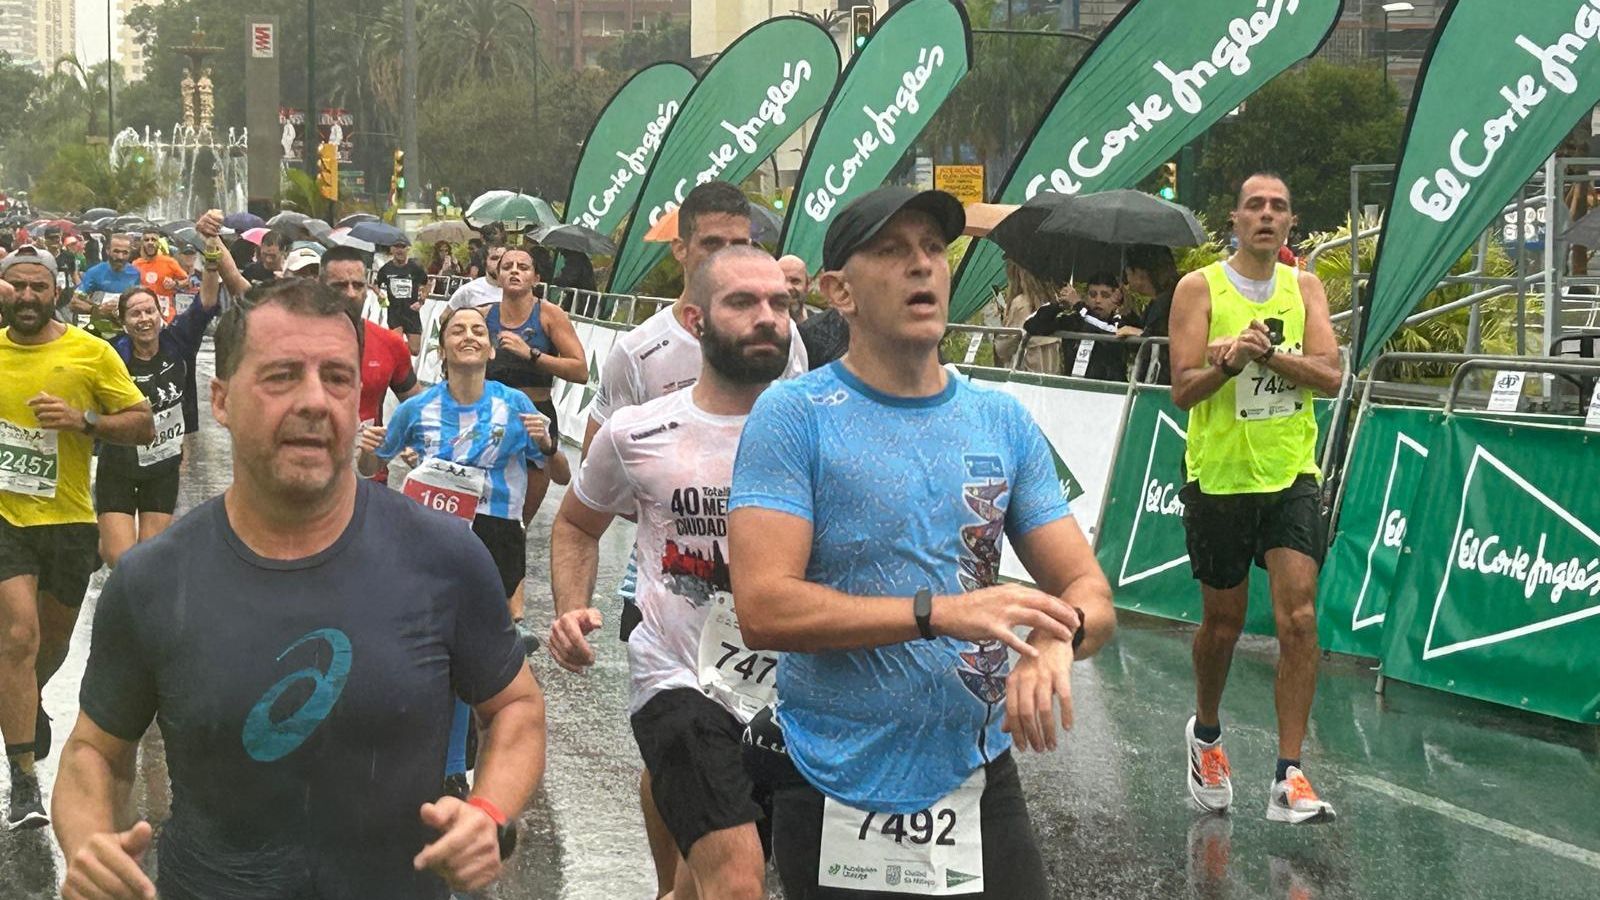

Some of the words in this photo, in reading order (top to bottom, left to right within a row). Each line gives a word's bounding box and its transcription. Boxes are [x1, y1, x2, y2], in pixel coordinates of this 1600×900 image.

[720, 59, 812, 154] Inglés
[1409, 168, 1470, 223] El
[1450, 74, 1548, 178] Corte
[1514, 0, 1600, 94] Ing
[804, 191, 836, 223] El
[824, 130, 880, 197] Corte
[863, 45, 944, 144] Inglés
[1068, 93, 1173, 178] Corte
[588, 168, 633, 217] Corte
[616, 100, 679, 175] Inglés
[1251, 375, 1297, 396] 742
[146, 423, 184, 450] 2802
[0, 450, 54, 477] 2457
[421, 489, 460, 514] 166
[671, 487, 700, 516] 40
[1145, 478, 1163, 513] El
[1160, 483, 1186, 517] Cor
[1458, 528, 1480, 570] El
[1478, 535, 1530, 581] Corte
[1525, 533, 1600, 603] Inglés
[715, 641, 778, 688] 747
[858, 808, 956, 846] 7492
